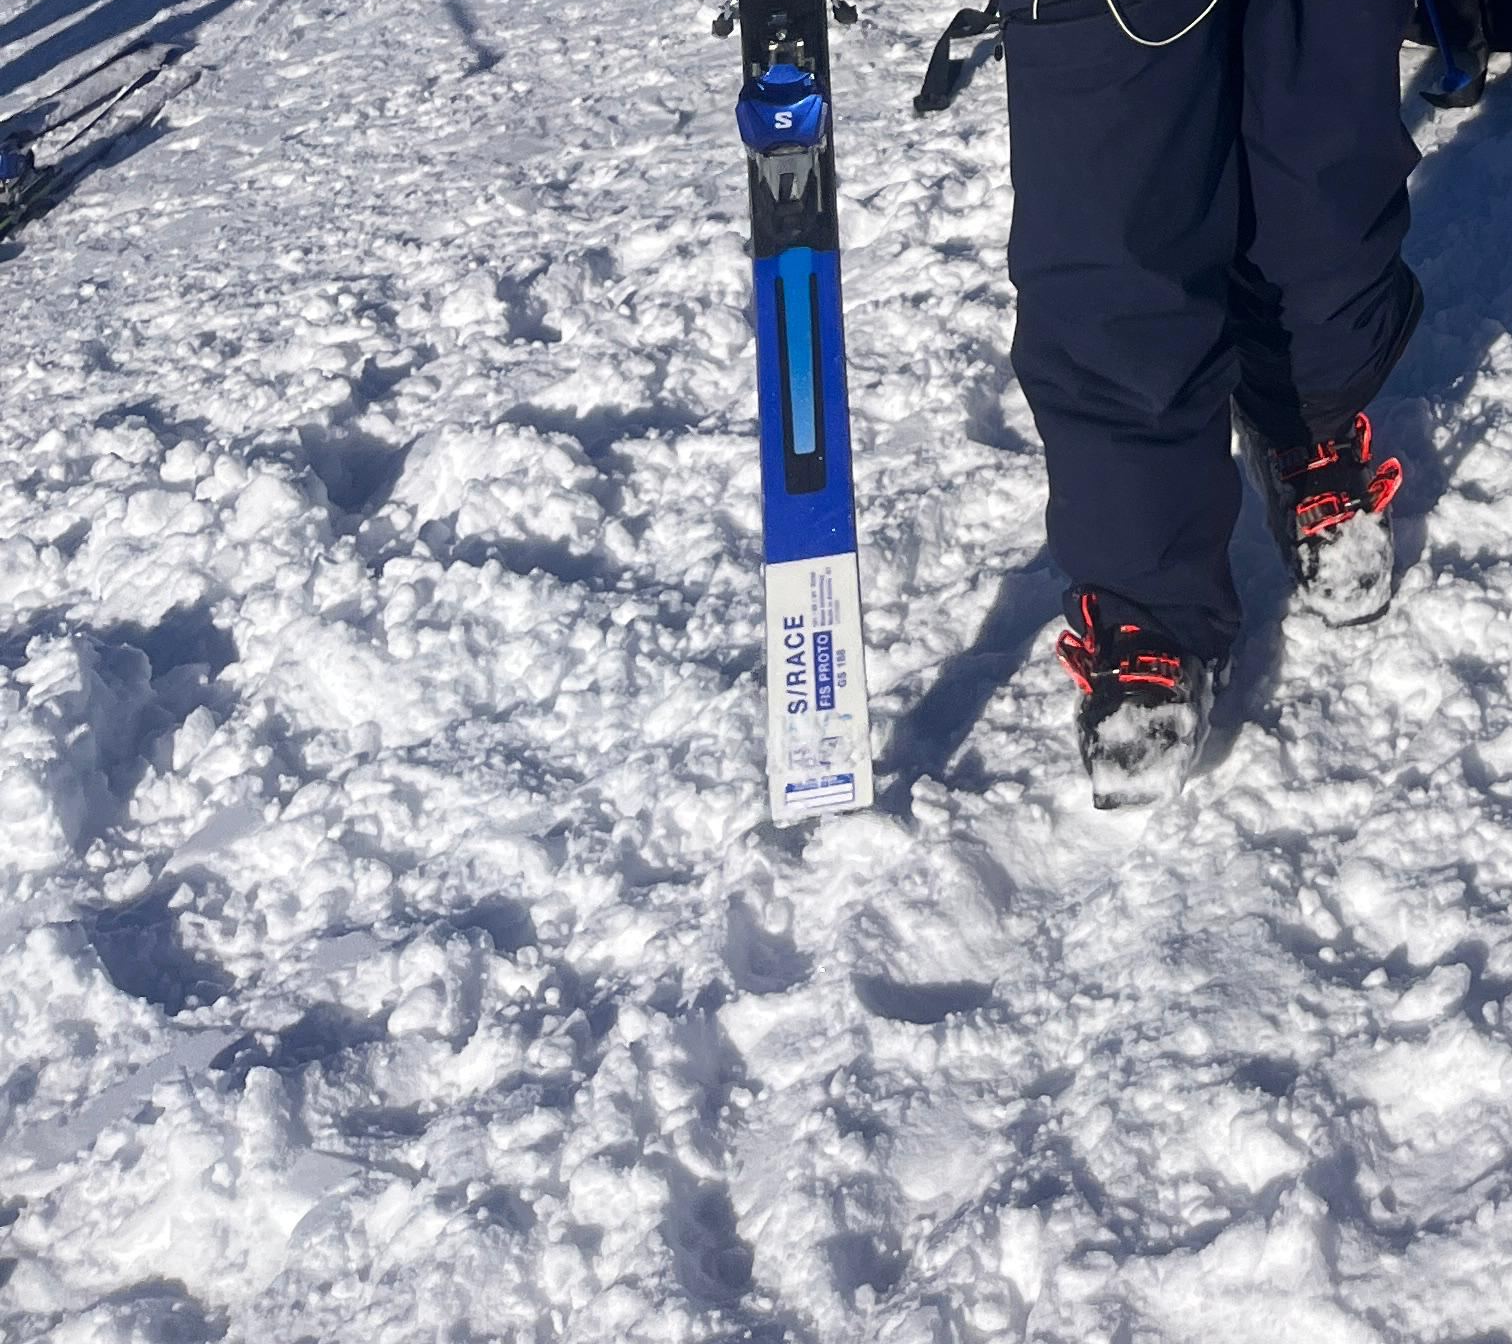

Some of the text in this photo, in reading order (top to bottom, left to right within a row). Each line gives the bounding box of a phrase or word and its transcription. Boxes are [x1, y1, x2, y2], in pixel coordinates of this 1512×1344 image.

[783, 614, 808, 714] S/RACE
[817, 633, 831, 683] PROTO
[819, 686, 832, 710] FIS
[837, 671, 848, 688] GS
